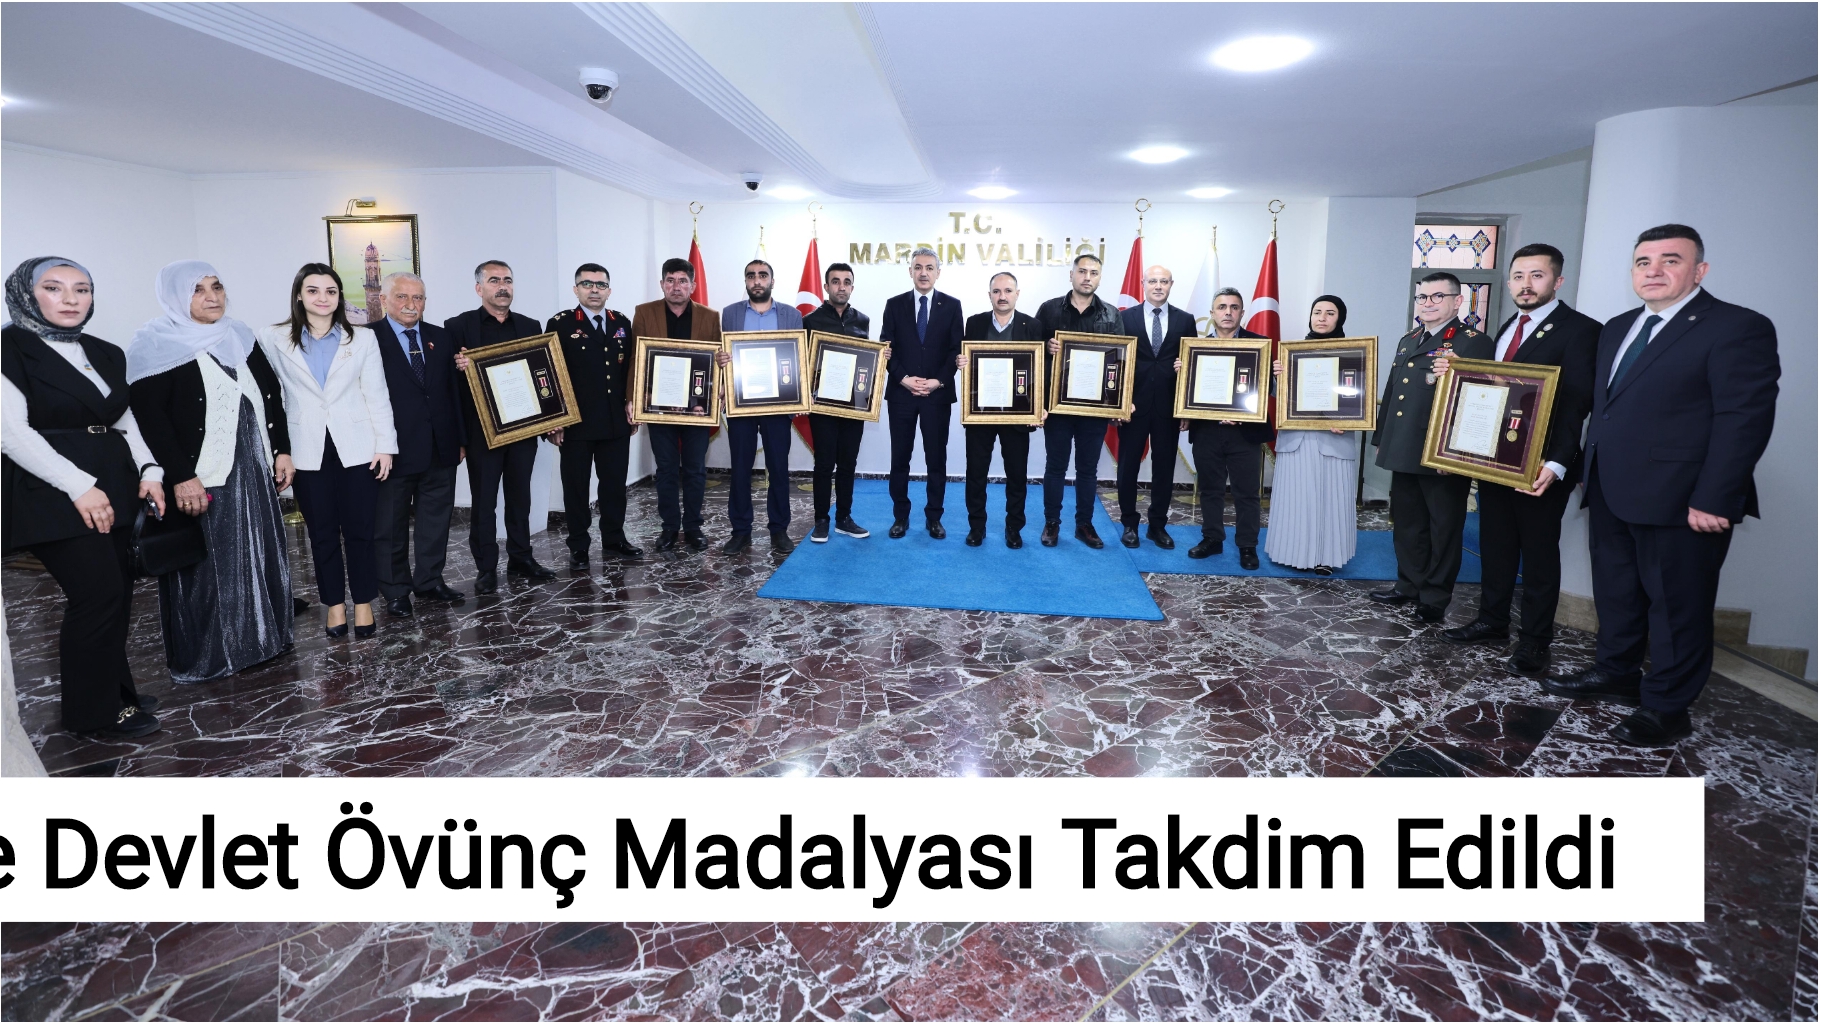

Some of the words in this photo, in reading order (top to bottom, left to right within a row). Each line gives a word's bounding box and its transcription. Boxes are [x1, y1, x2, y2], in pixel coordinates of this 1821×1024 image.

[948, 211, 1002, 235] T.C.
[849, 237, 966, 266] MARİN
[977, 237, 1106, 267] VALİLİĞİ
